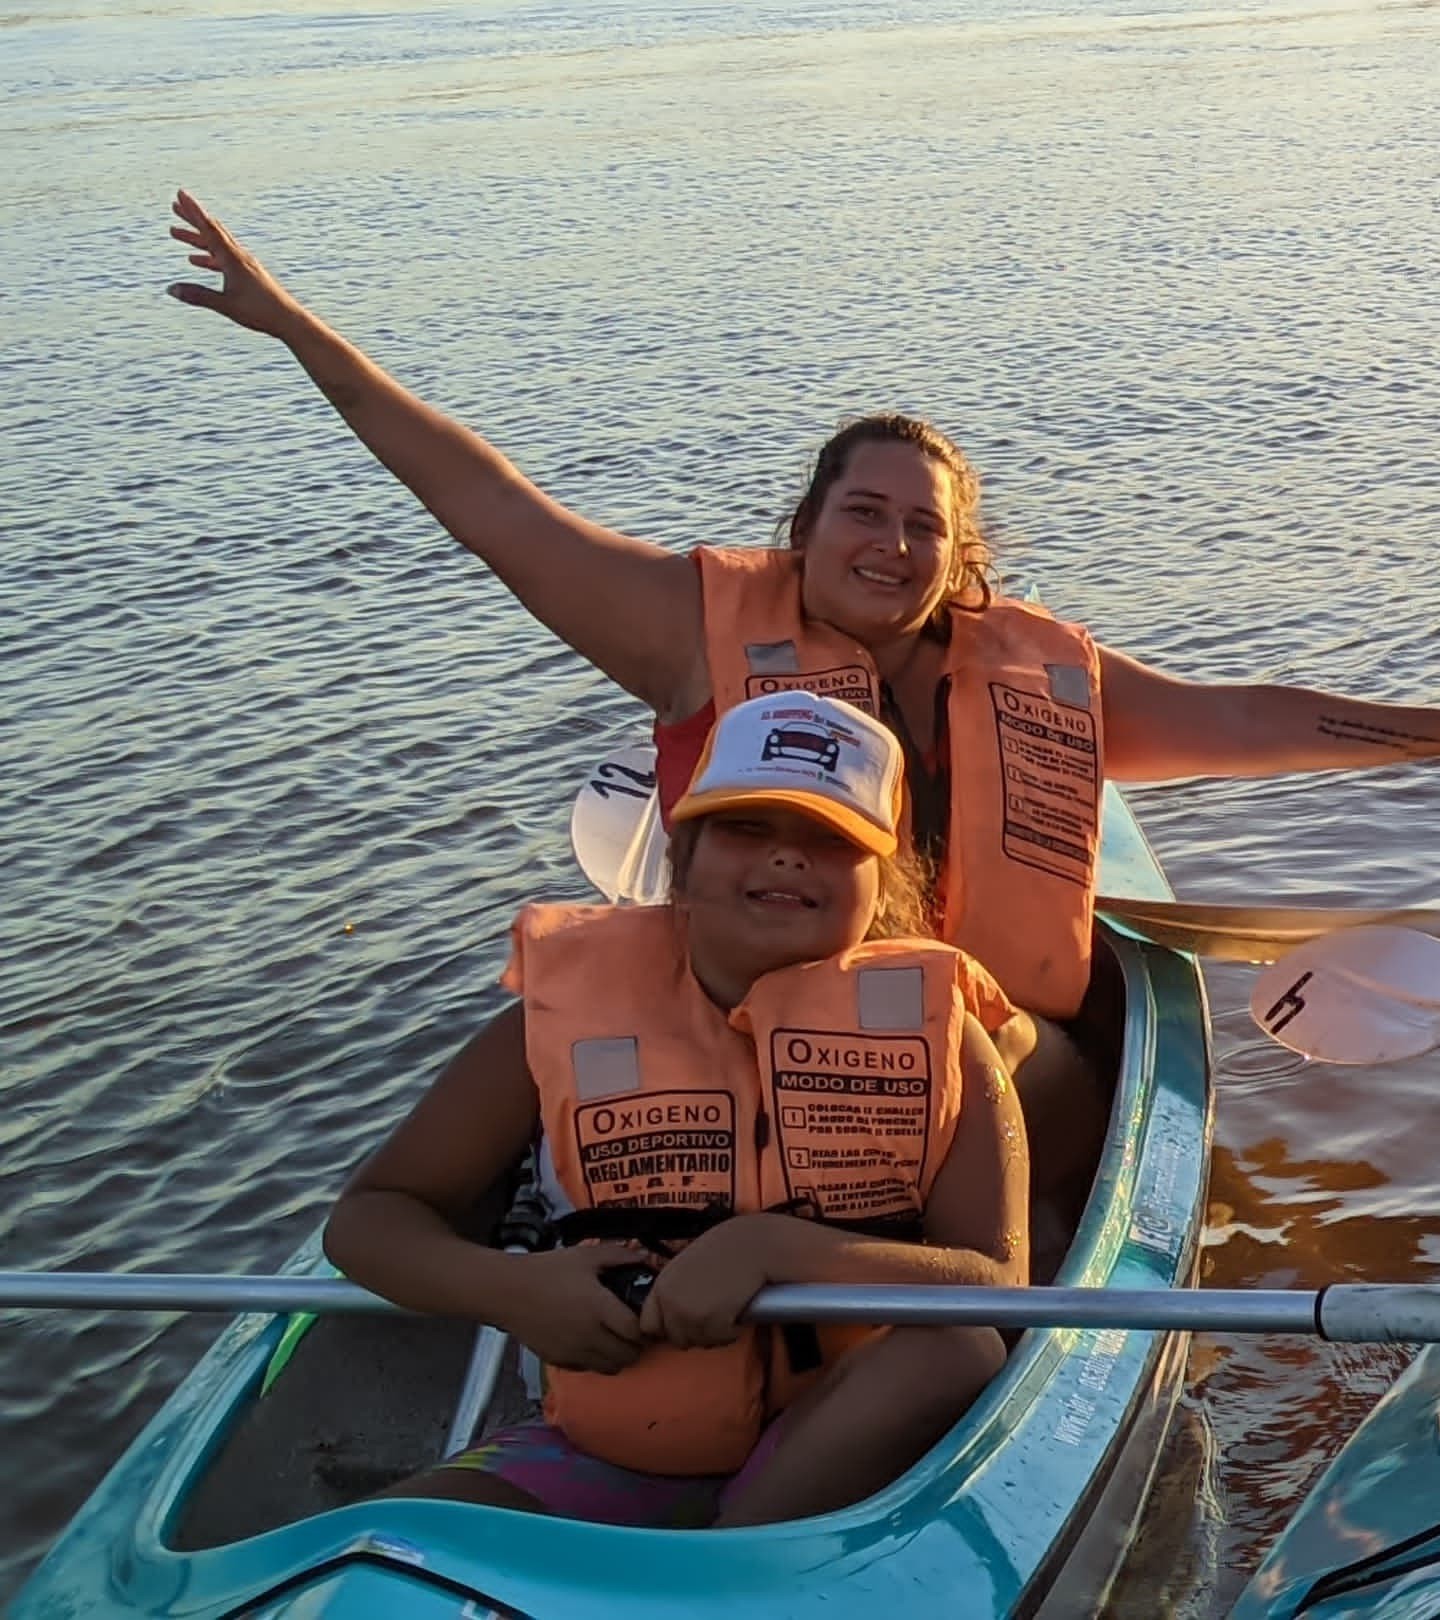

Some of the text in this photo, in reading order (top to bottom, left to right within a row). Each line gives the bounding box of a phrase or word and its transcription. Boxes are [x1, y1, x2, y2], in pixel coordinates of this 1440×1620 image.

[1003, 690, 1087, 734] OXIGENO
[590, 763, 657, 798] 12
[787, 1038, 915, 1070] OXIGENO
[780, 1075, 925, 1095] MODO DE USO
[593, 1105, 721, 1134] OXIGENO
[589, 1133, 729, 1161] USO DEPORTIVO
[587, 1152, 731, 1184] REGLAMENTARIO
